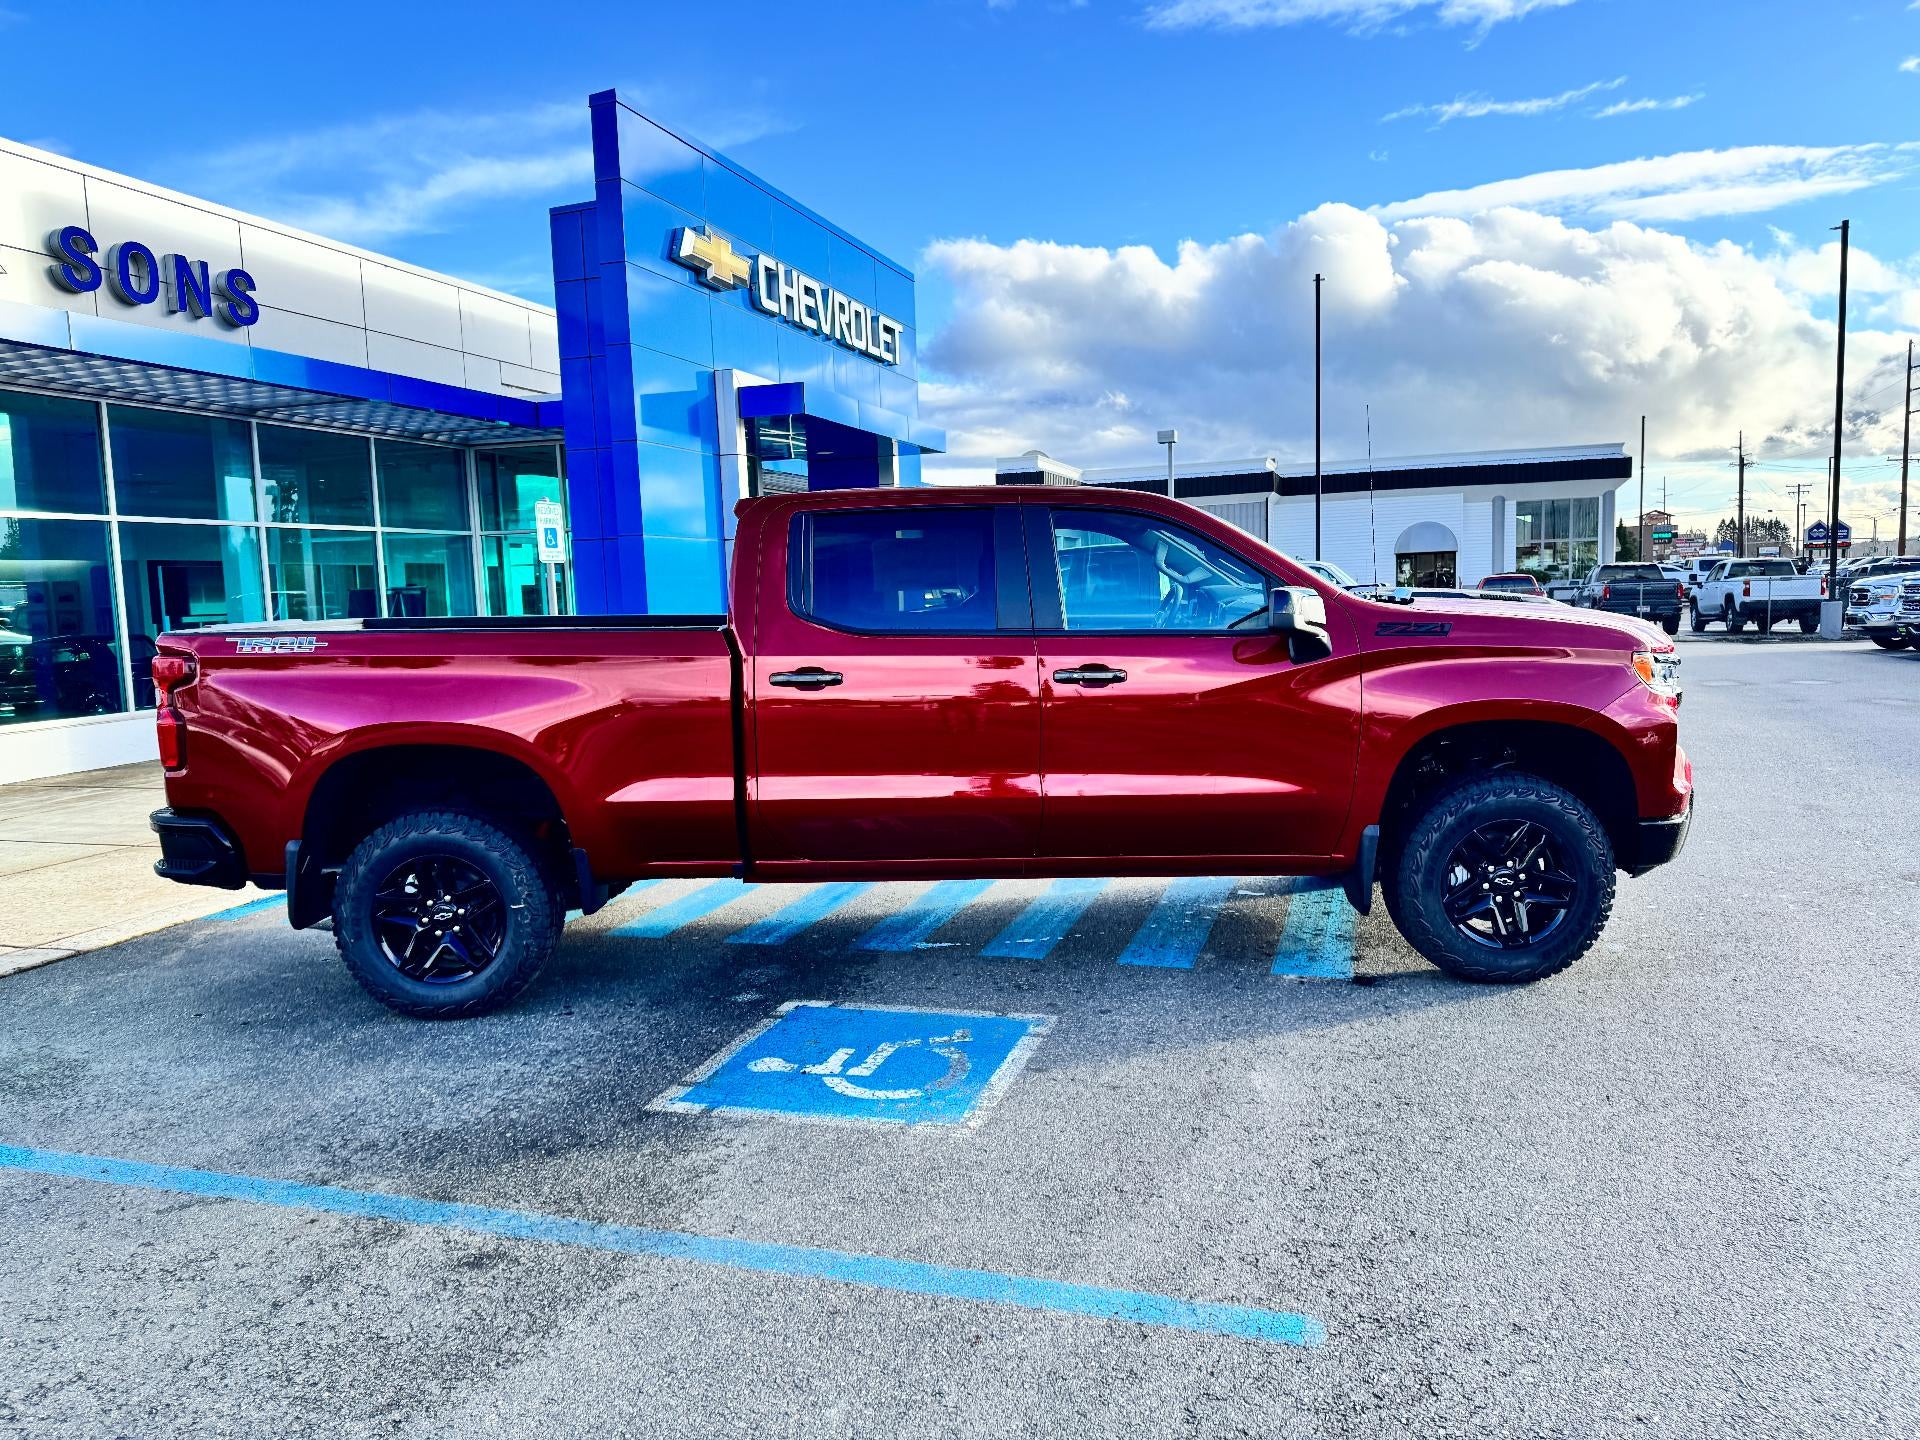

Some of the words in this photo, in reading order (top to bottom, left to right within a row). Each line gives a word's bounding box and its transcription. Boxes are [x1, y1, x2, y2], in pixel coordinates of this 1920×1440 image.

[50, 226, 259, 327] SONS
[755, 254, 903, 365] CHEVROLET
[226, 636, 328, 648] TRAIL
